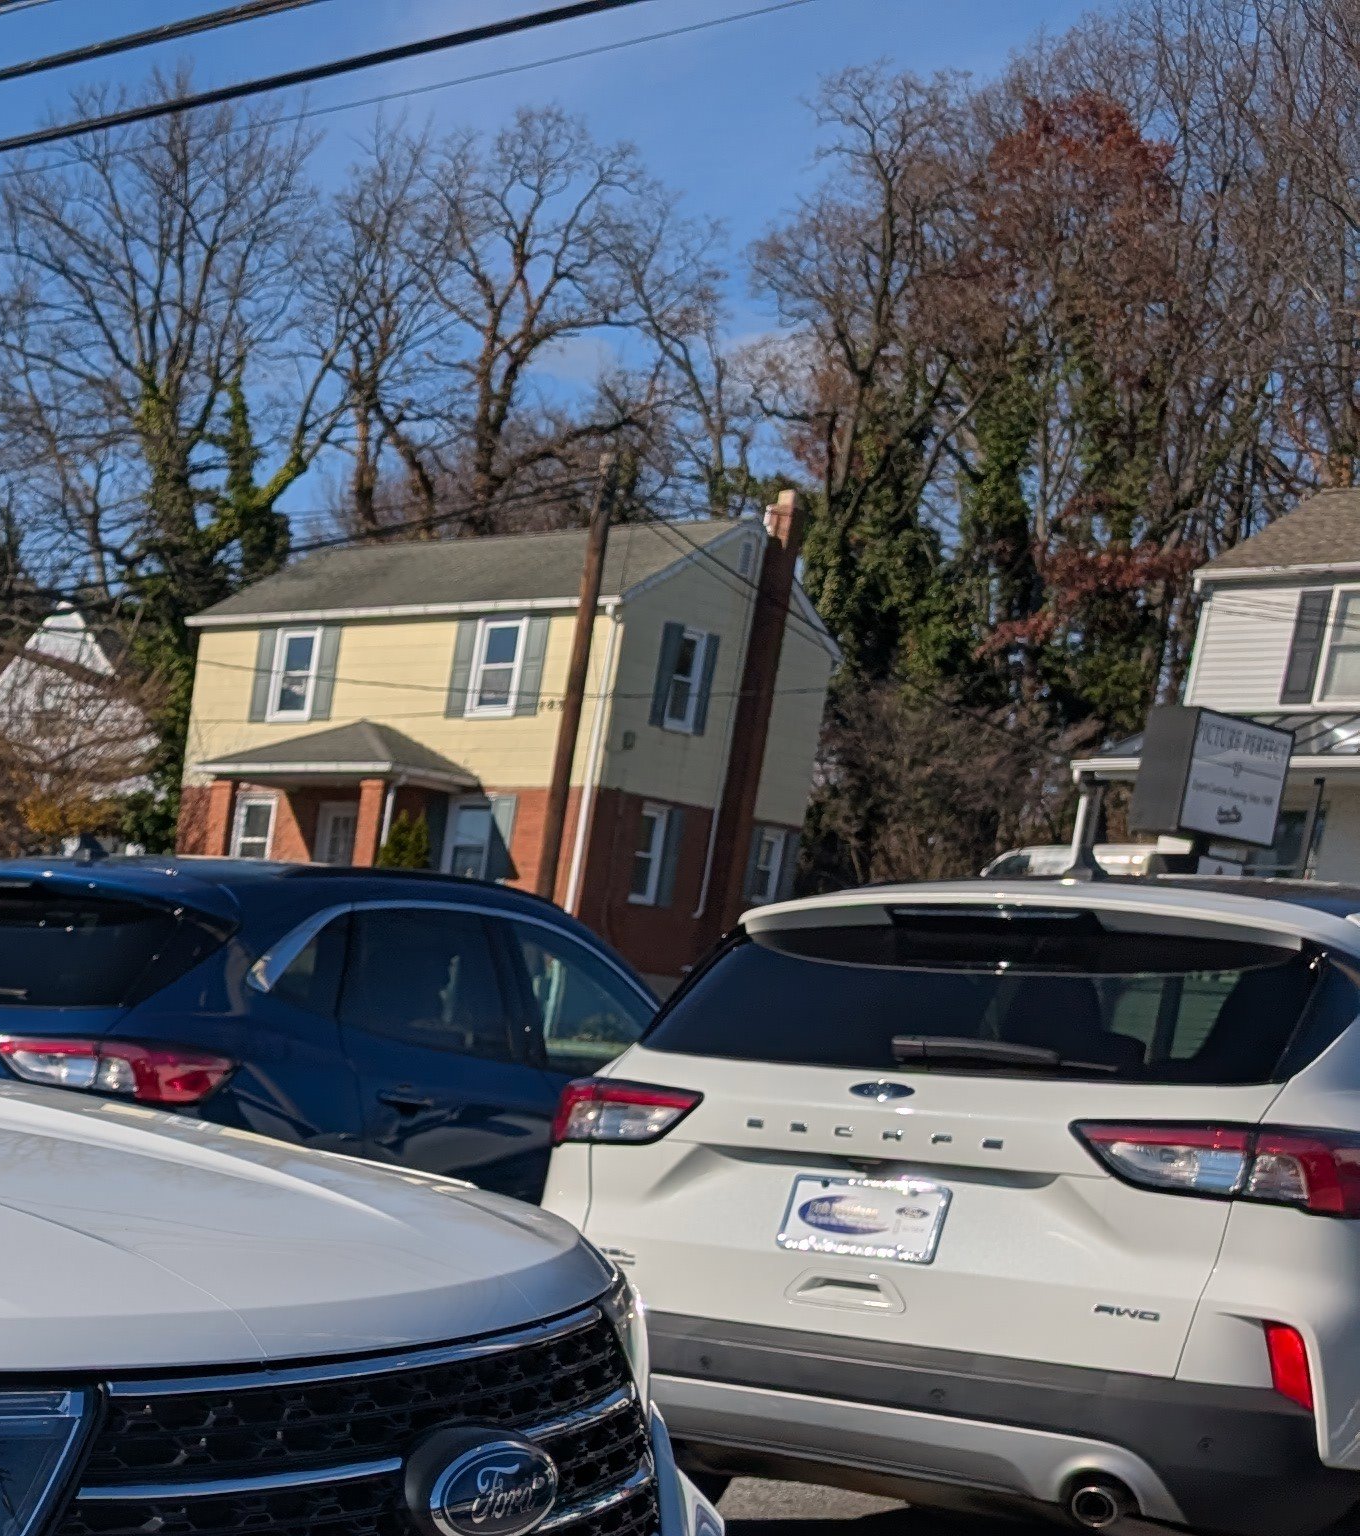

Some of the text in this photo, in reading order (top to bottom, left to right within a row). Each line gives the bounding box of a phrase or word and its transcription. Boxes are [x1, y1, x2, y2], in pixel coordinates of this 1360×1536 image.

[746, 1118, 1004, 1151] ESCAPE
[1092, 1304, 1160, 1322] AWD
[471, 1463, 546, 1524] Ford
